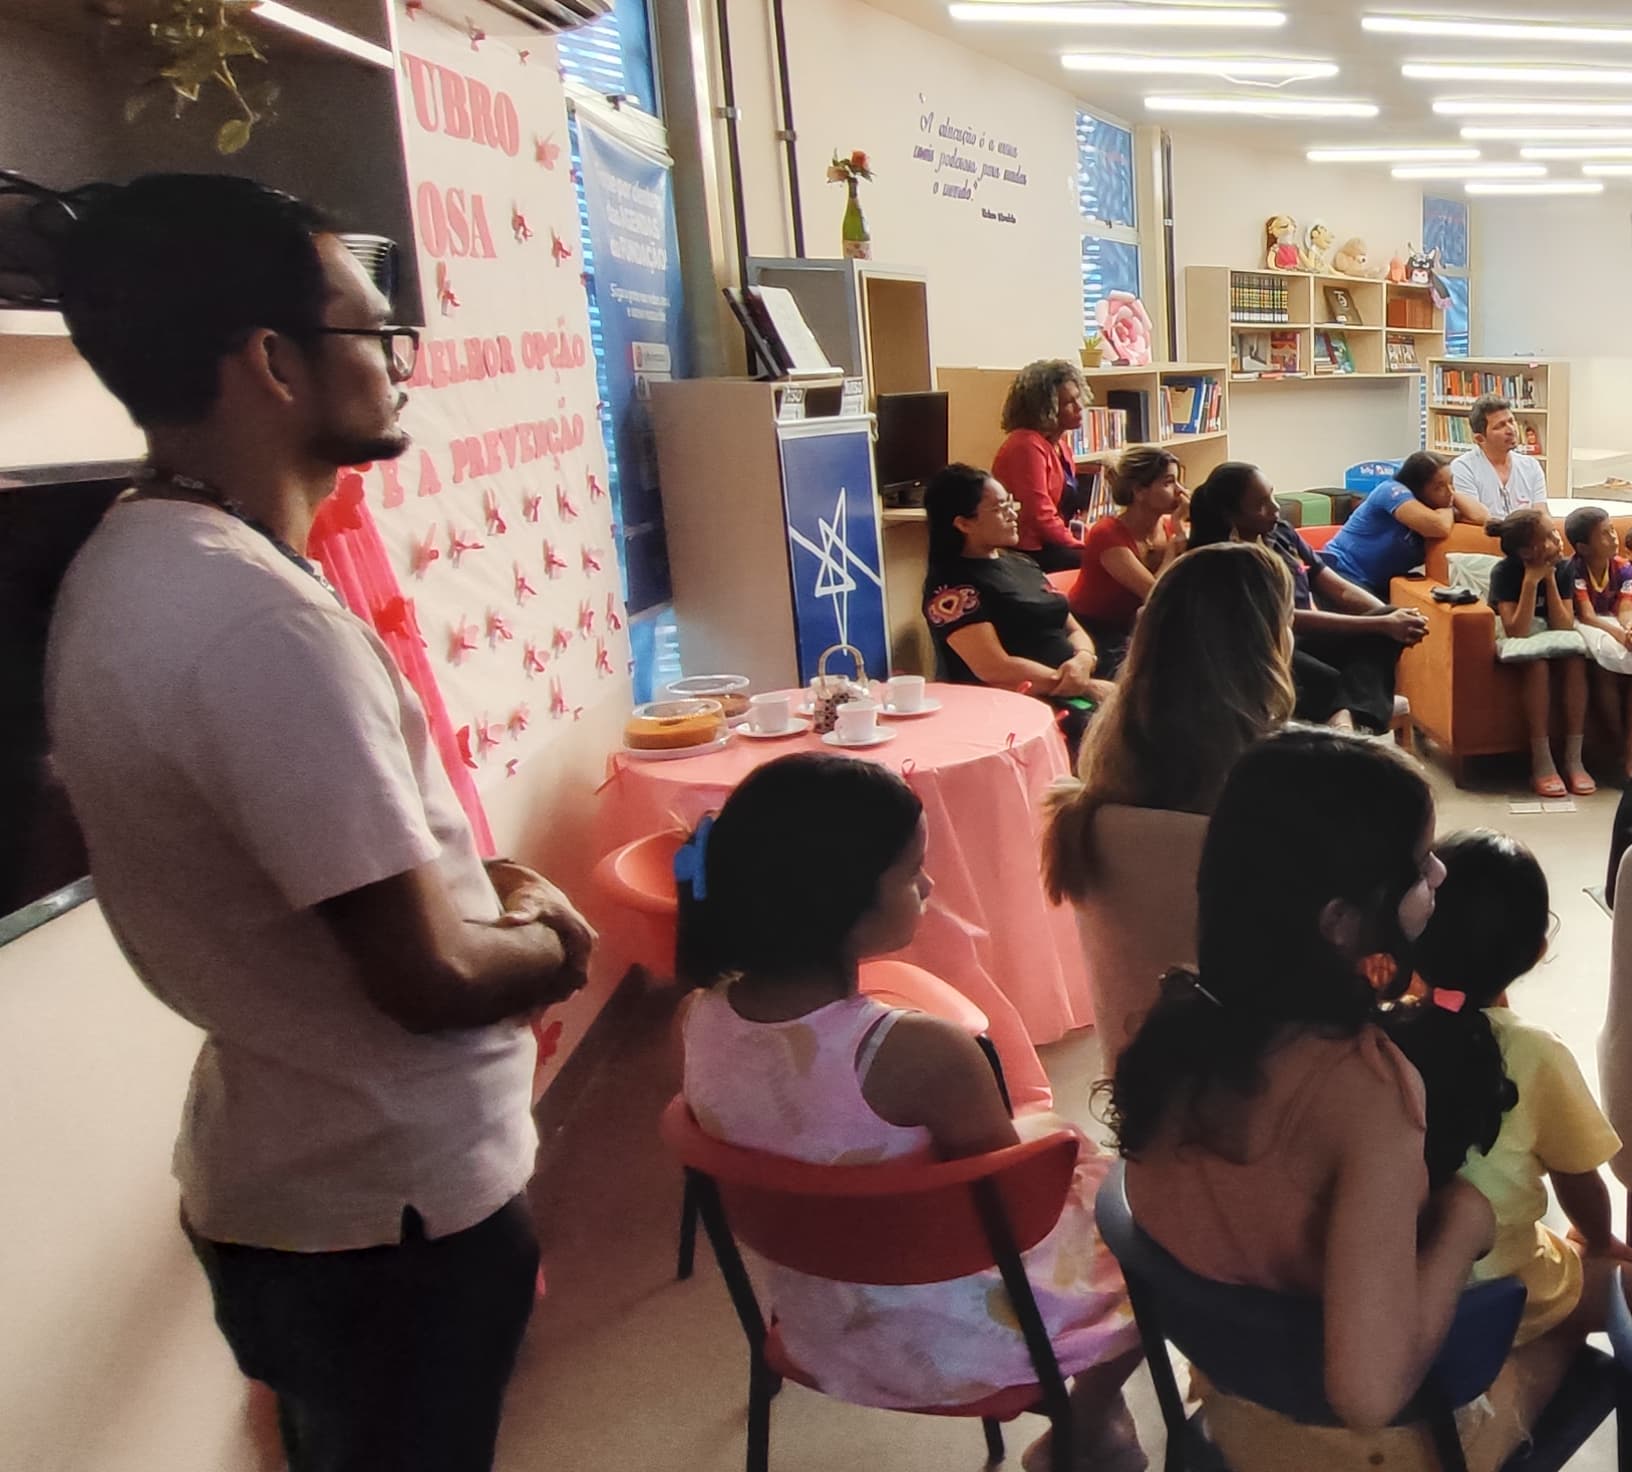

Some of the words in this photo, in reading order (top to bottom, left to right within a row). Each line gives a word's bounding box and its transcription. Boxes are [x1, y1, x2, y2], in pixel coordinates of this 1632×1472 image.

[417, 181, 499, 259] OSA
[521, 316, 586, 384] OPÇÃO
[418, 449, 443, 498] A
[449, 396, 585, 488] PREVENÇÃO
